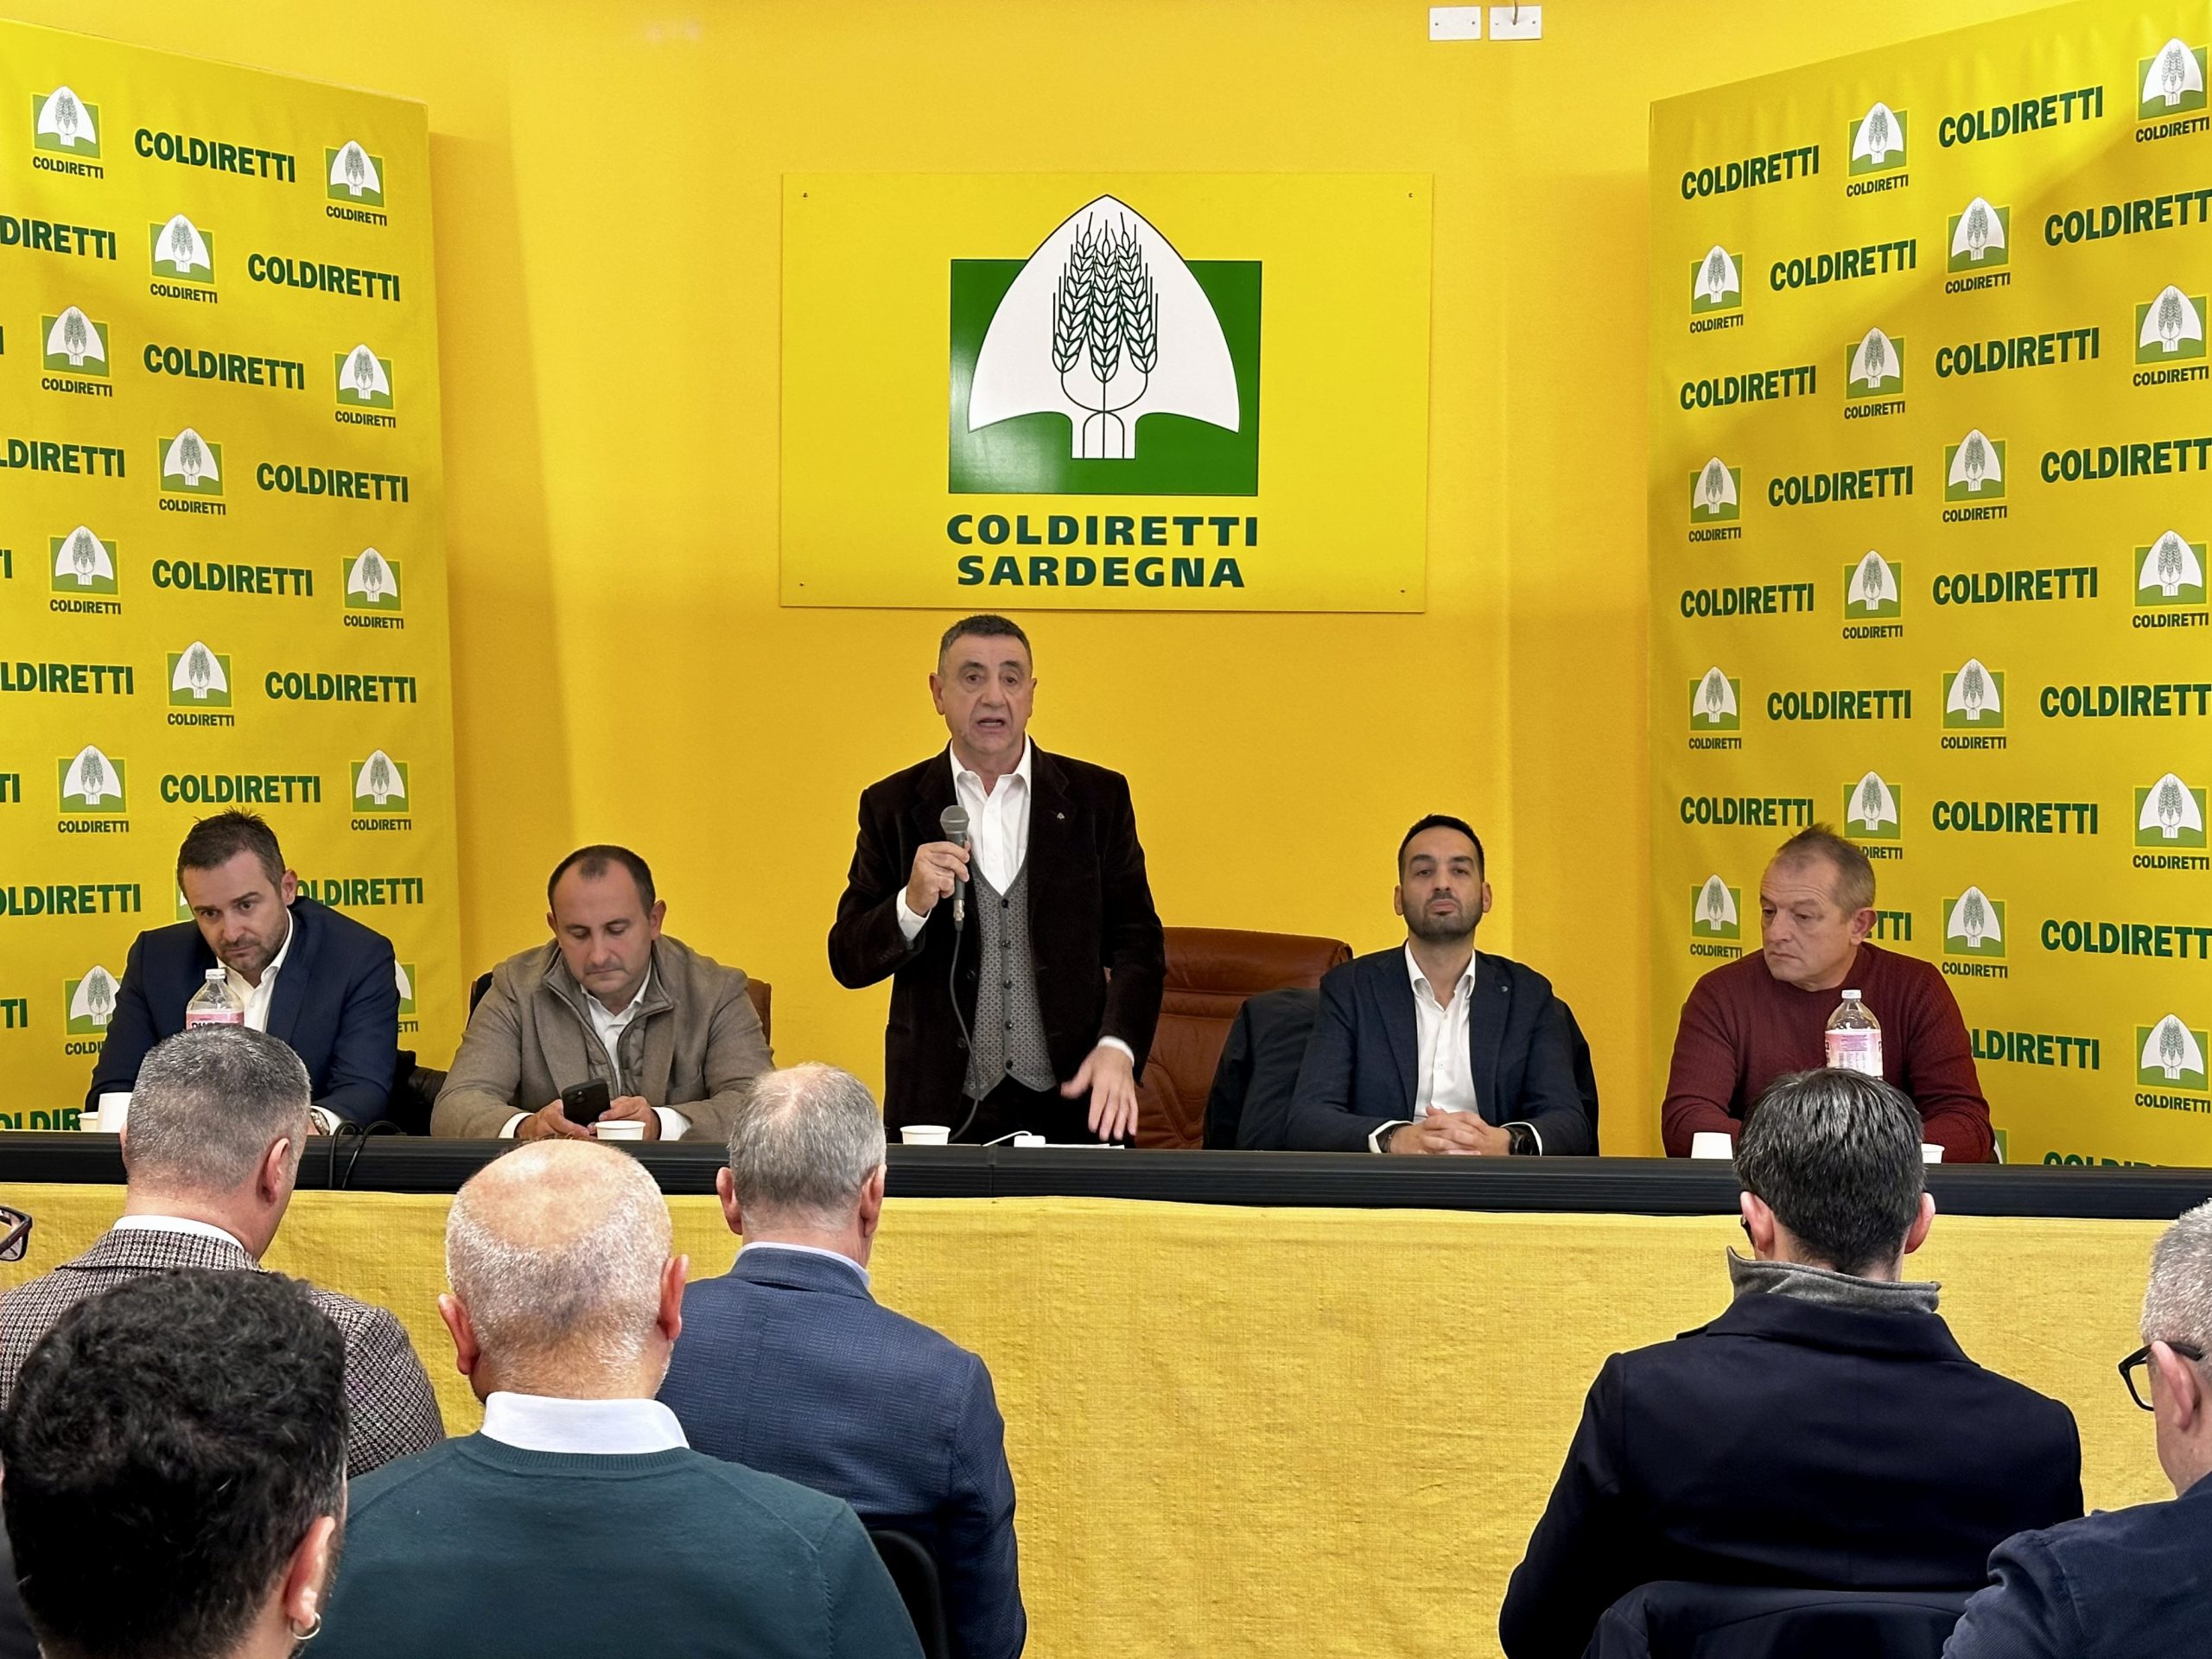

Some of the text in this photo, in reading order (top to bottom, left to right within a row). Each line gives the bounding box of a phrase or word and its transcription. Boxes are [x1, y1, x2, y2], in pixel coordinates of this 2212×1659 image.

[1939, 86, 2103, 148] COLDIRETTI
[2135, 116, 2210, 143] COLDIRETTI
[134, 128, 296, 183] COLDIRETTI
[33, 156, 104, 180] COLDIRETTI
[1681, 144, 1819, 200] COLDIRETTI
[1847, 174, 1909, 197] COLDIRETTI
[326, 206, 387, 226] COLDIRETTI
[1770, 238, 1916, 291] COLDIRETTI
[247, 253, 400, 302] COLDIRETTI
[1945, 272, 2011, 295] COLDIRETTI
[149, 283, 218, 304] COLDIRETTI
[1689, 314, 1744, 334] COLDIRETTI
[1936, 327, 2100, 378] COLDIRETTI
[143, 344, 305, 391] COLDIRETTI
[2133, 365, 2209, 387] COLDIRETTI
[41, 378, 112, 397] COLDIRETTI
[1680, 365, 1816, 410] COLDIRETTI
[334, 410, 397, 429] COLDIRETTI
[1844, 400, 1905, 420] COLDIRETTI
[256, 462, 409, 503] COLDIRETTI
[1768, 465, 1913, 507] COLDIRETTI
[159, 499, 226, 516] COLDIRETTI
[1942, 505, 2007, 523] COLDIRETTI
[947, 515, 1257, 546] COLDIRETTI
[1688, 526, 1742, 543] COLDIRETTI
[152, 559, 313, 597] COLDIRETTI
[958, 556, 1245, 588] SARDEGNA
[1932, 566, 2098, 606] COLDIRETTI
[49, 599, 121, 615] COLDIRETTI
[1680, 582, 1815, 619] COLDIRETTI
[343, 615, 404, 630] COLDIRETTI
[1842, 625, 1904, 639] COLDIRETTI
[2132, 612, 2209, 629] COLDIRETTI
[264, 671, 416, 703] COLDIRETTI
[1767, 690, 1911, 721] COLDIRETTI
[167, 713, 235, 727] COLDIRETTI
[1688, 737, 1742, 750] COLDIRETTI
[1941, 736, 2006, 749] COLDIRETTI
[160, 774, 321, 804] COLDIRETTI
[1680, 796, 1814, 827] COLDIRETTI
[1932, 800, 2098, 835] COLDIRETTI
[57, 820, 130, 833] COLDIRETTI
[351, 818, 412, 831] COLDIRETTI
[2133, 855, 2209, 870] COLDIRETTI
[1689, 943, 1743, 959] COLDIRETTI
[1942, 961, 2008, 979] COLDIRETTI
[2134, 1093, 2211, 1114] COLDIRETTI
